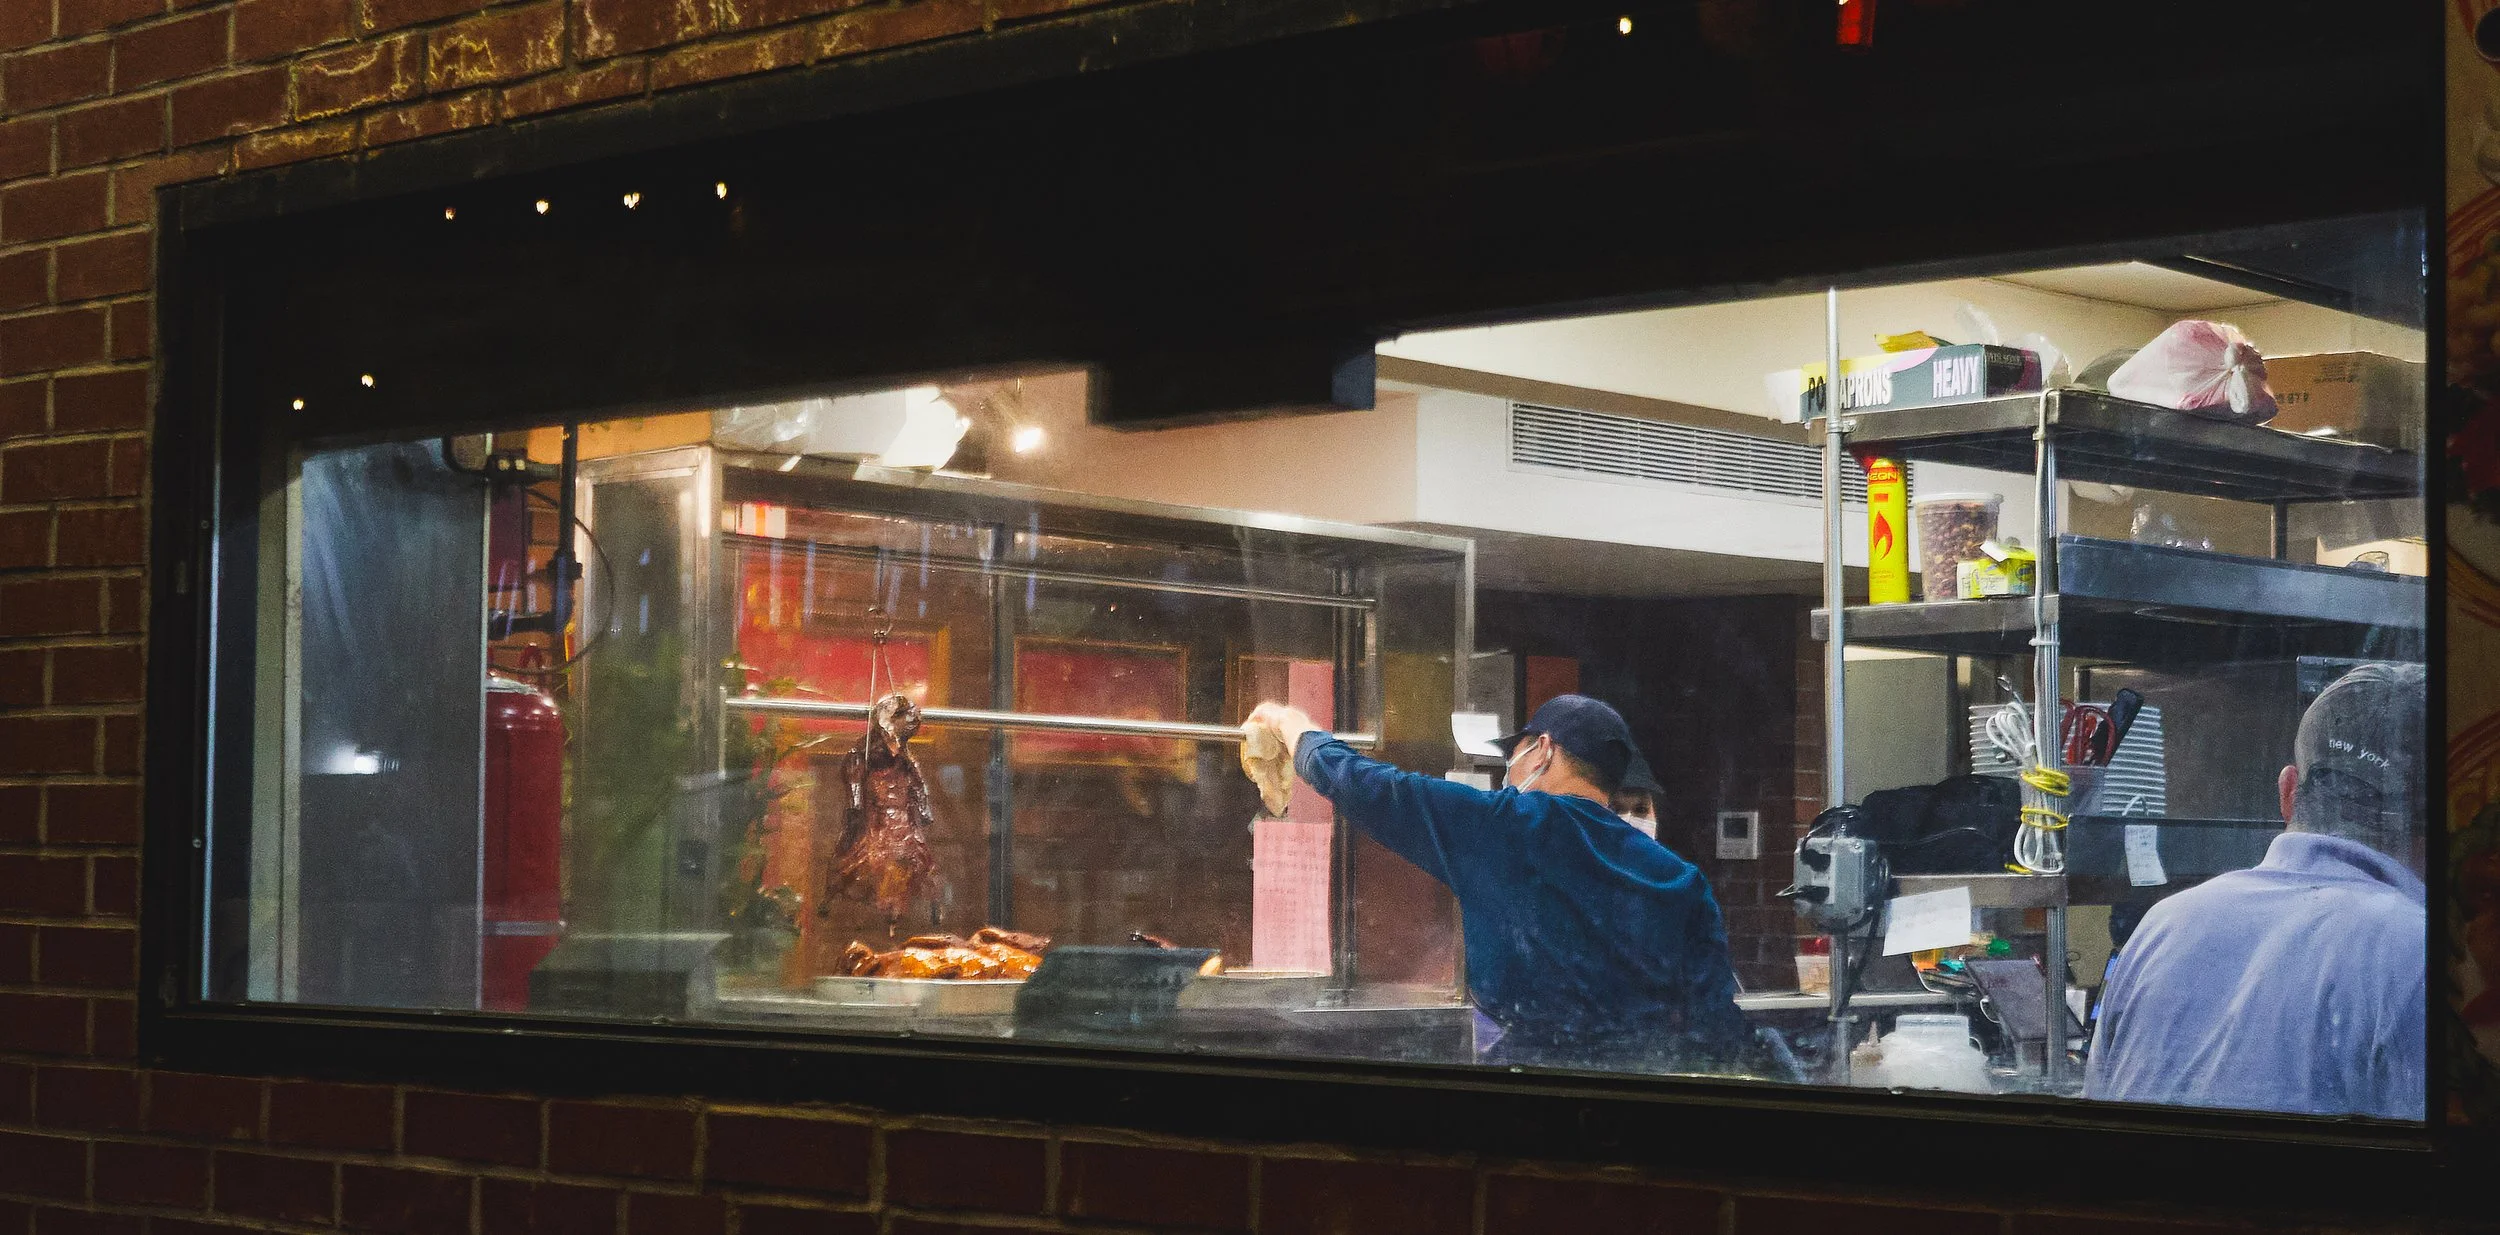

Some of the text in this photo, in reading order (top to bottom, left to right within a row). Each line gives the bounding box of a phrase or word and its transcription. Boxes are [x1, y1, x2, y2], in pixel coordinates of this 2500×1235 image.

[1839, 367, 1891, 410] APRONS
[1932, 356, 1980, 399] HEAVY
[2328, 738, 2391, 770] new york
